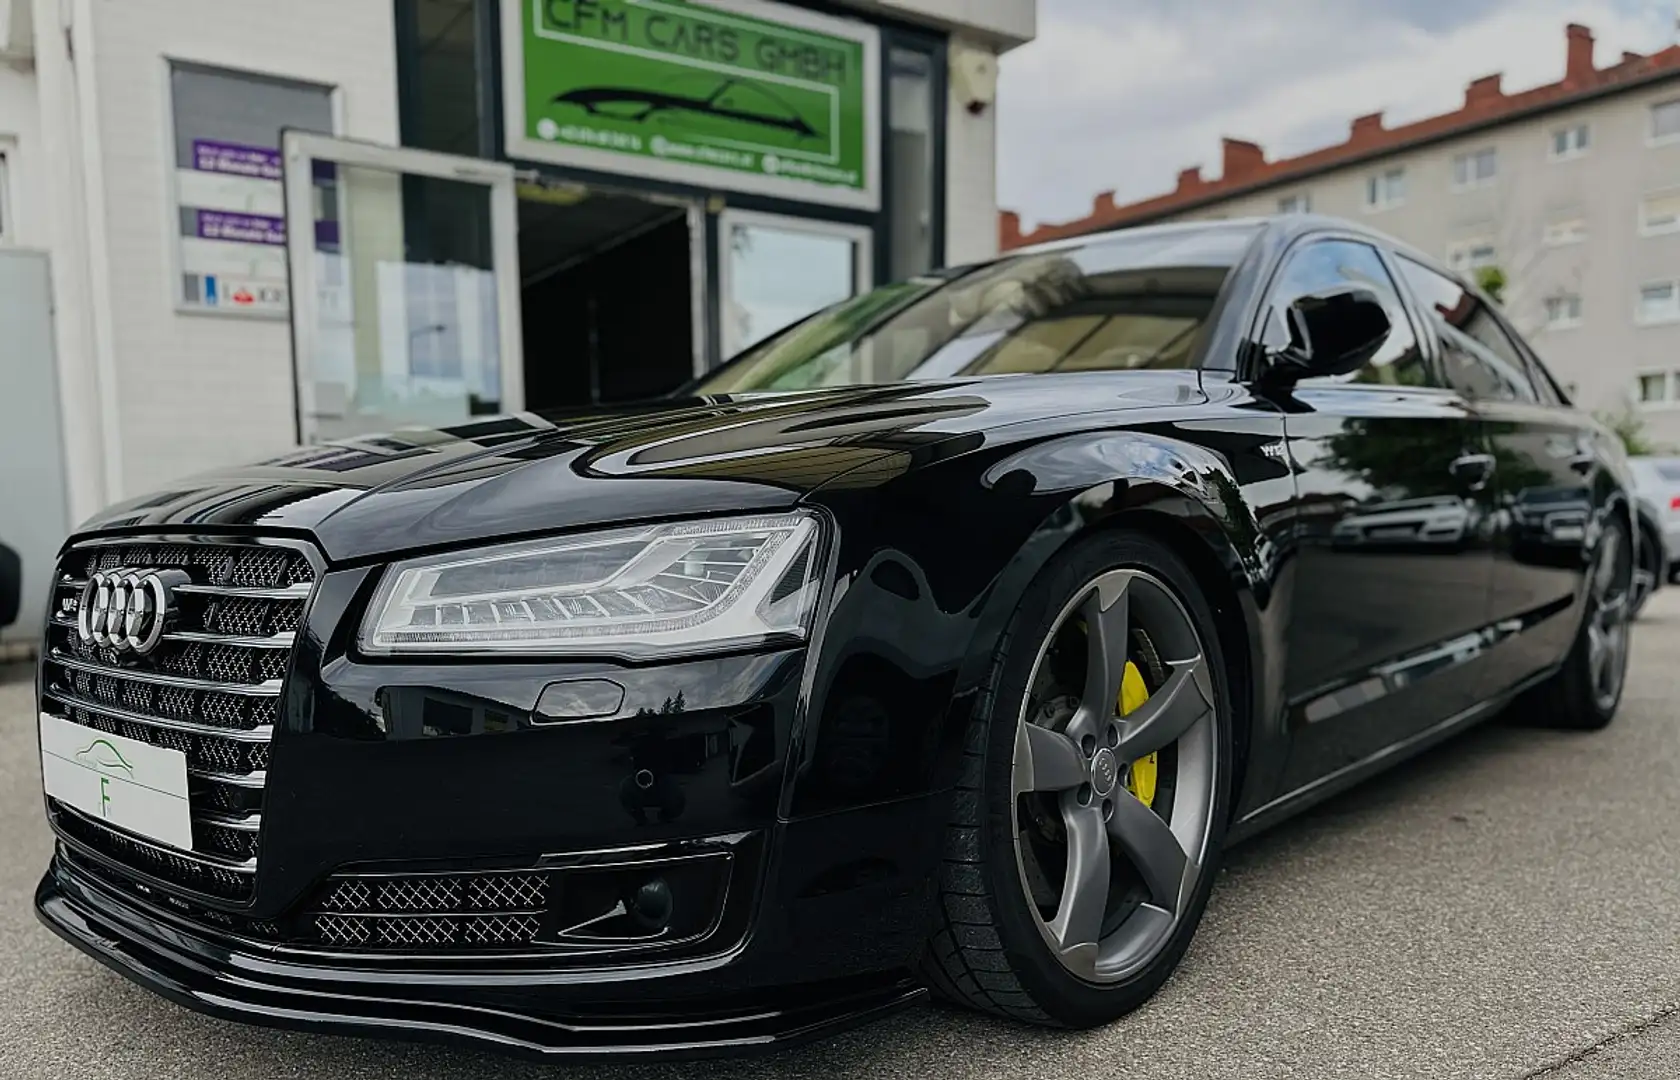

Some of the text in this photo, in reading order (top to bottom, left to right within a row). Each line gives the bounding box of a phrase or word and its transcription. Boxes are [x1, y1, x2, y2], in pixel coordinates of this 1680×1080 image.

[547, 0, 846, 84] CFM CARS GMBH
